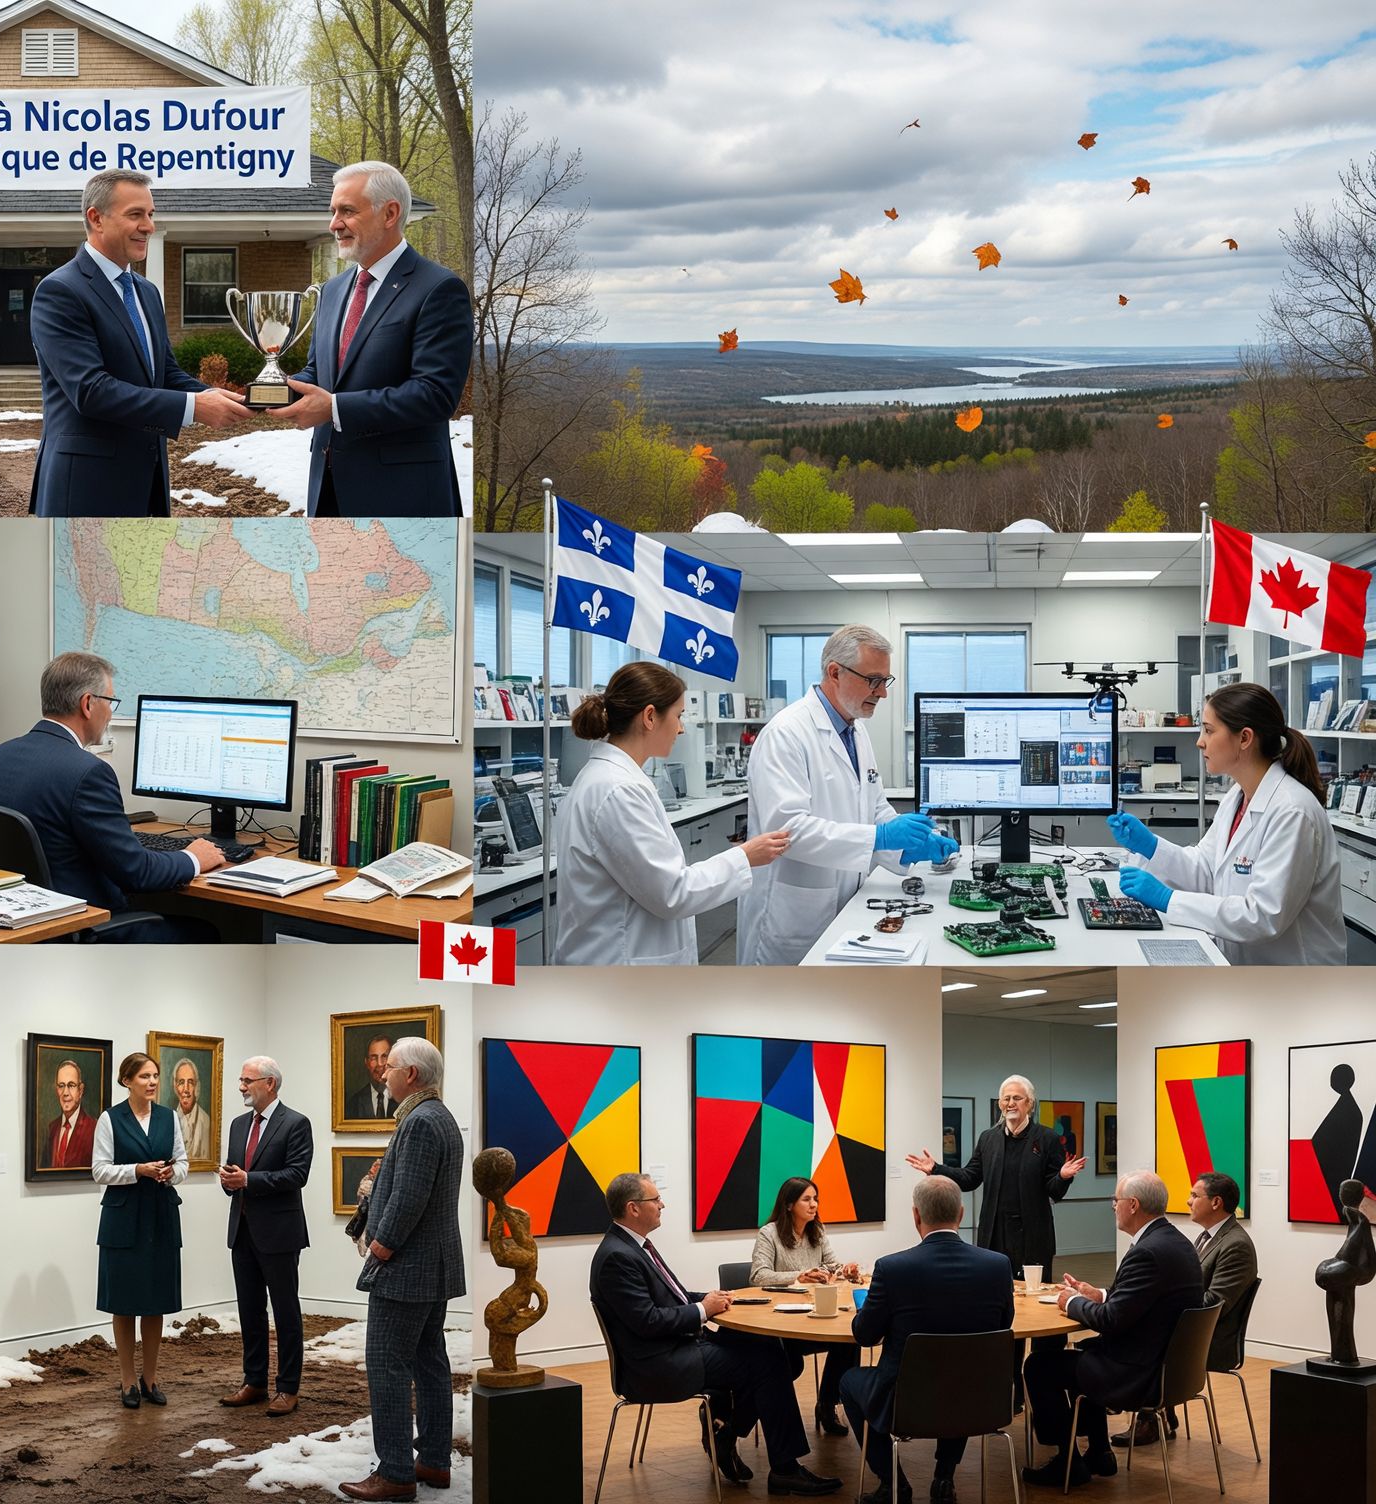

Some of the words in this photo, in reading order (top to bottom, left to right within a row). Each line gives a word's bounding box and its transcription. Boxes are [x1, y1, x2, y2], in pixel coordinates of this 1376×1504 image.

[24, 99, 151, 132] Nicolas
[163, 98, 286, 132] Dufour
[68, 141, 107, 170] de
[117, 141, 295, 179] Repentigny
